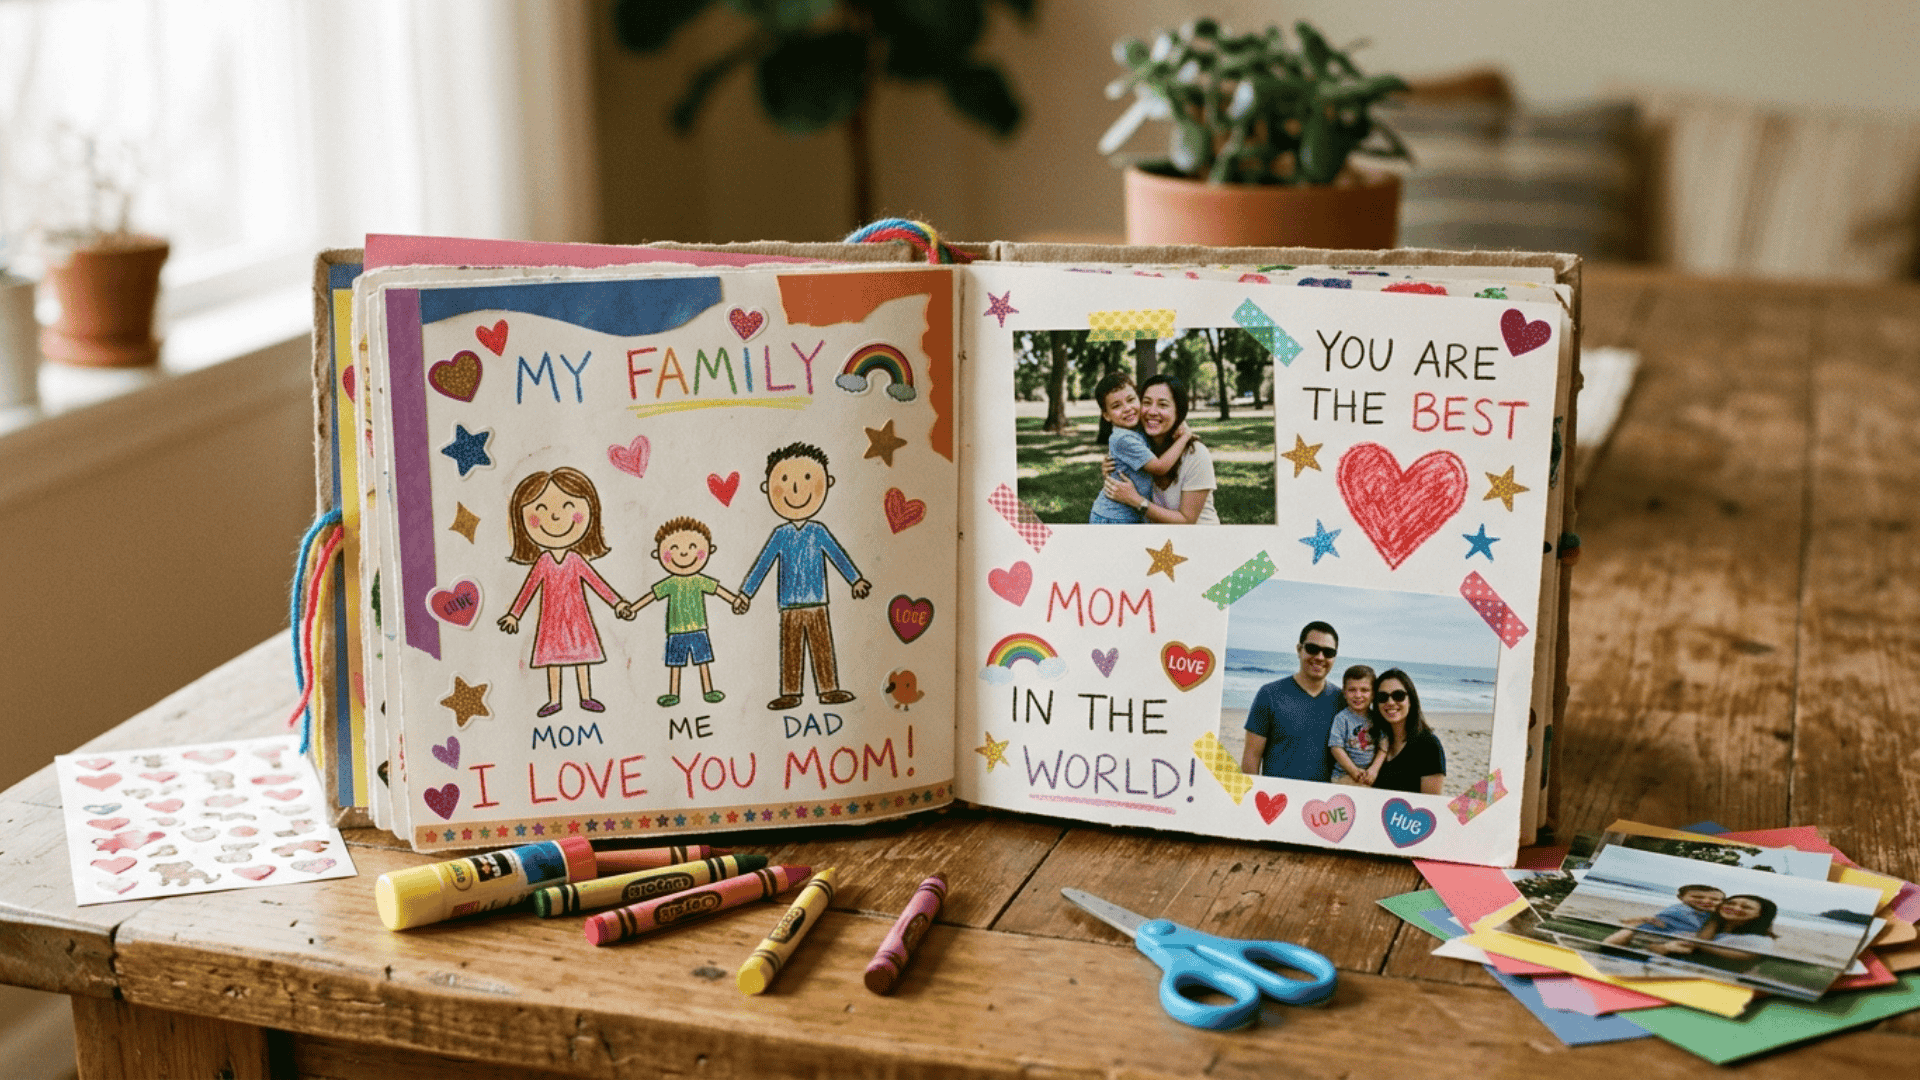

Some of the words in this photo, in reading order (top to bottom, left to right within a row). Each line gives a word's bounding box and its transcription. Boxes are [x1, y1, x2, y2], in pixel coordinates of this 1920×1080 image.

[517, 351, 593, 404] MY
[626, 340, 825, 400] FAMILY
[1316, 329, 1394, 372] YOU
[1413, 340, 1500, 381] ARE
[1302, 386, 1387, 425] THE
[1411, 391, 1530, 440] BEST
[1046, 581, 1156, 634] MOM
[1168, 655, 1206, 675] LOVE
[667, 715, 714, 740] ME
[783, 712, 844, 739] DAD
[1010, 685, 1053, 726] IN
[1078, 693, 1168, 735] THE
[531, 722, 604, 751] MOM
[468, 763, 499, 809] I
[528, 755, 648, 805] LOVE
[672, 752, 758, 800] YOU
[783, 725, 917, 790] MOM!
[1022, 744, 1197, 803] WORLD!
[1311, 806, 1346, 827] LOVE
